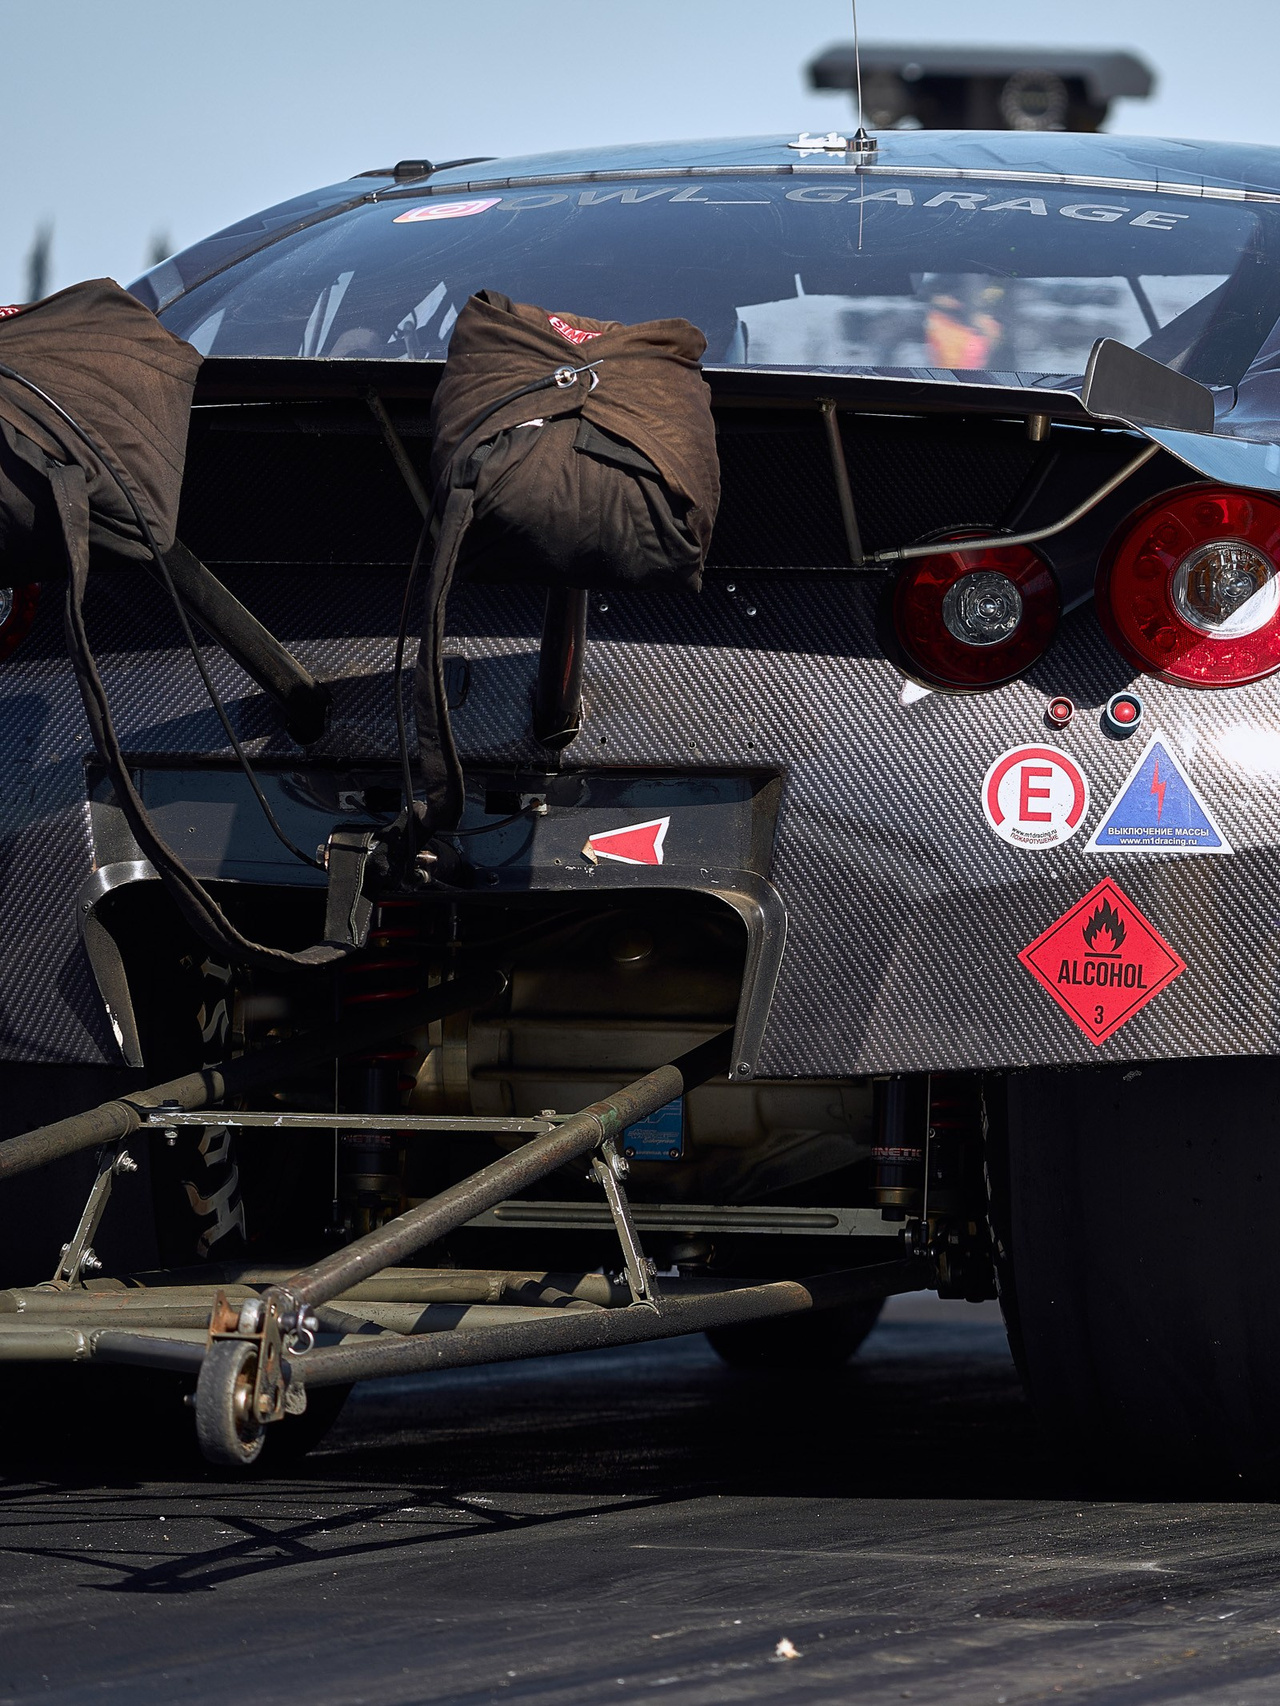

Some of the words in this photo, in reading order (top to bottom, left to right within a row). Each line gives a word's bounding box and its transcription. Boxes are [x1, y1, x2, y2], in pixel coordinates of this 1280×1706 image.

[1018, 766, 1053, 822] E
[1107, 827, 1174, 837] ВЫКЛЮЧЕНИЕ
[1174, 828, 1210, 837] МАССЫ
[1119, 837, 1198, 847] www.m1dracing.ru
[1057, 959, 1148, 989] ALCOHOL
[1093, 1004, 1105, 1025] 3
